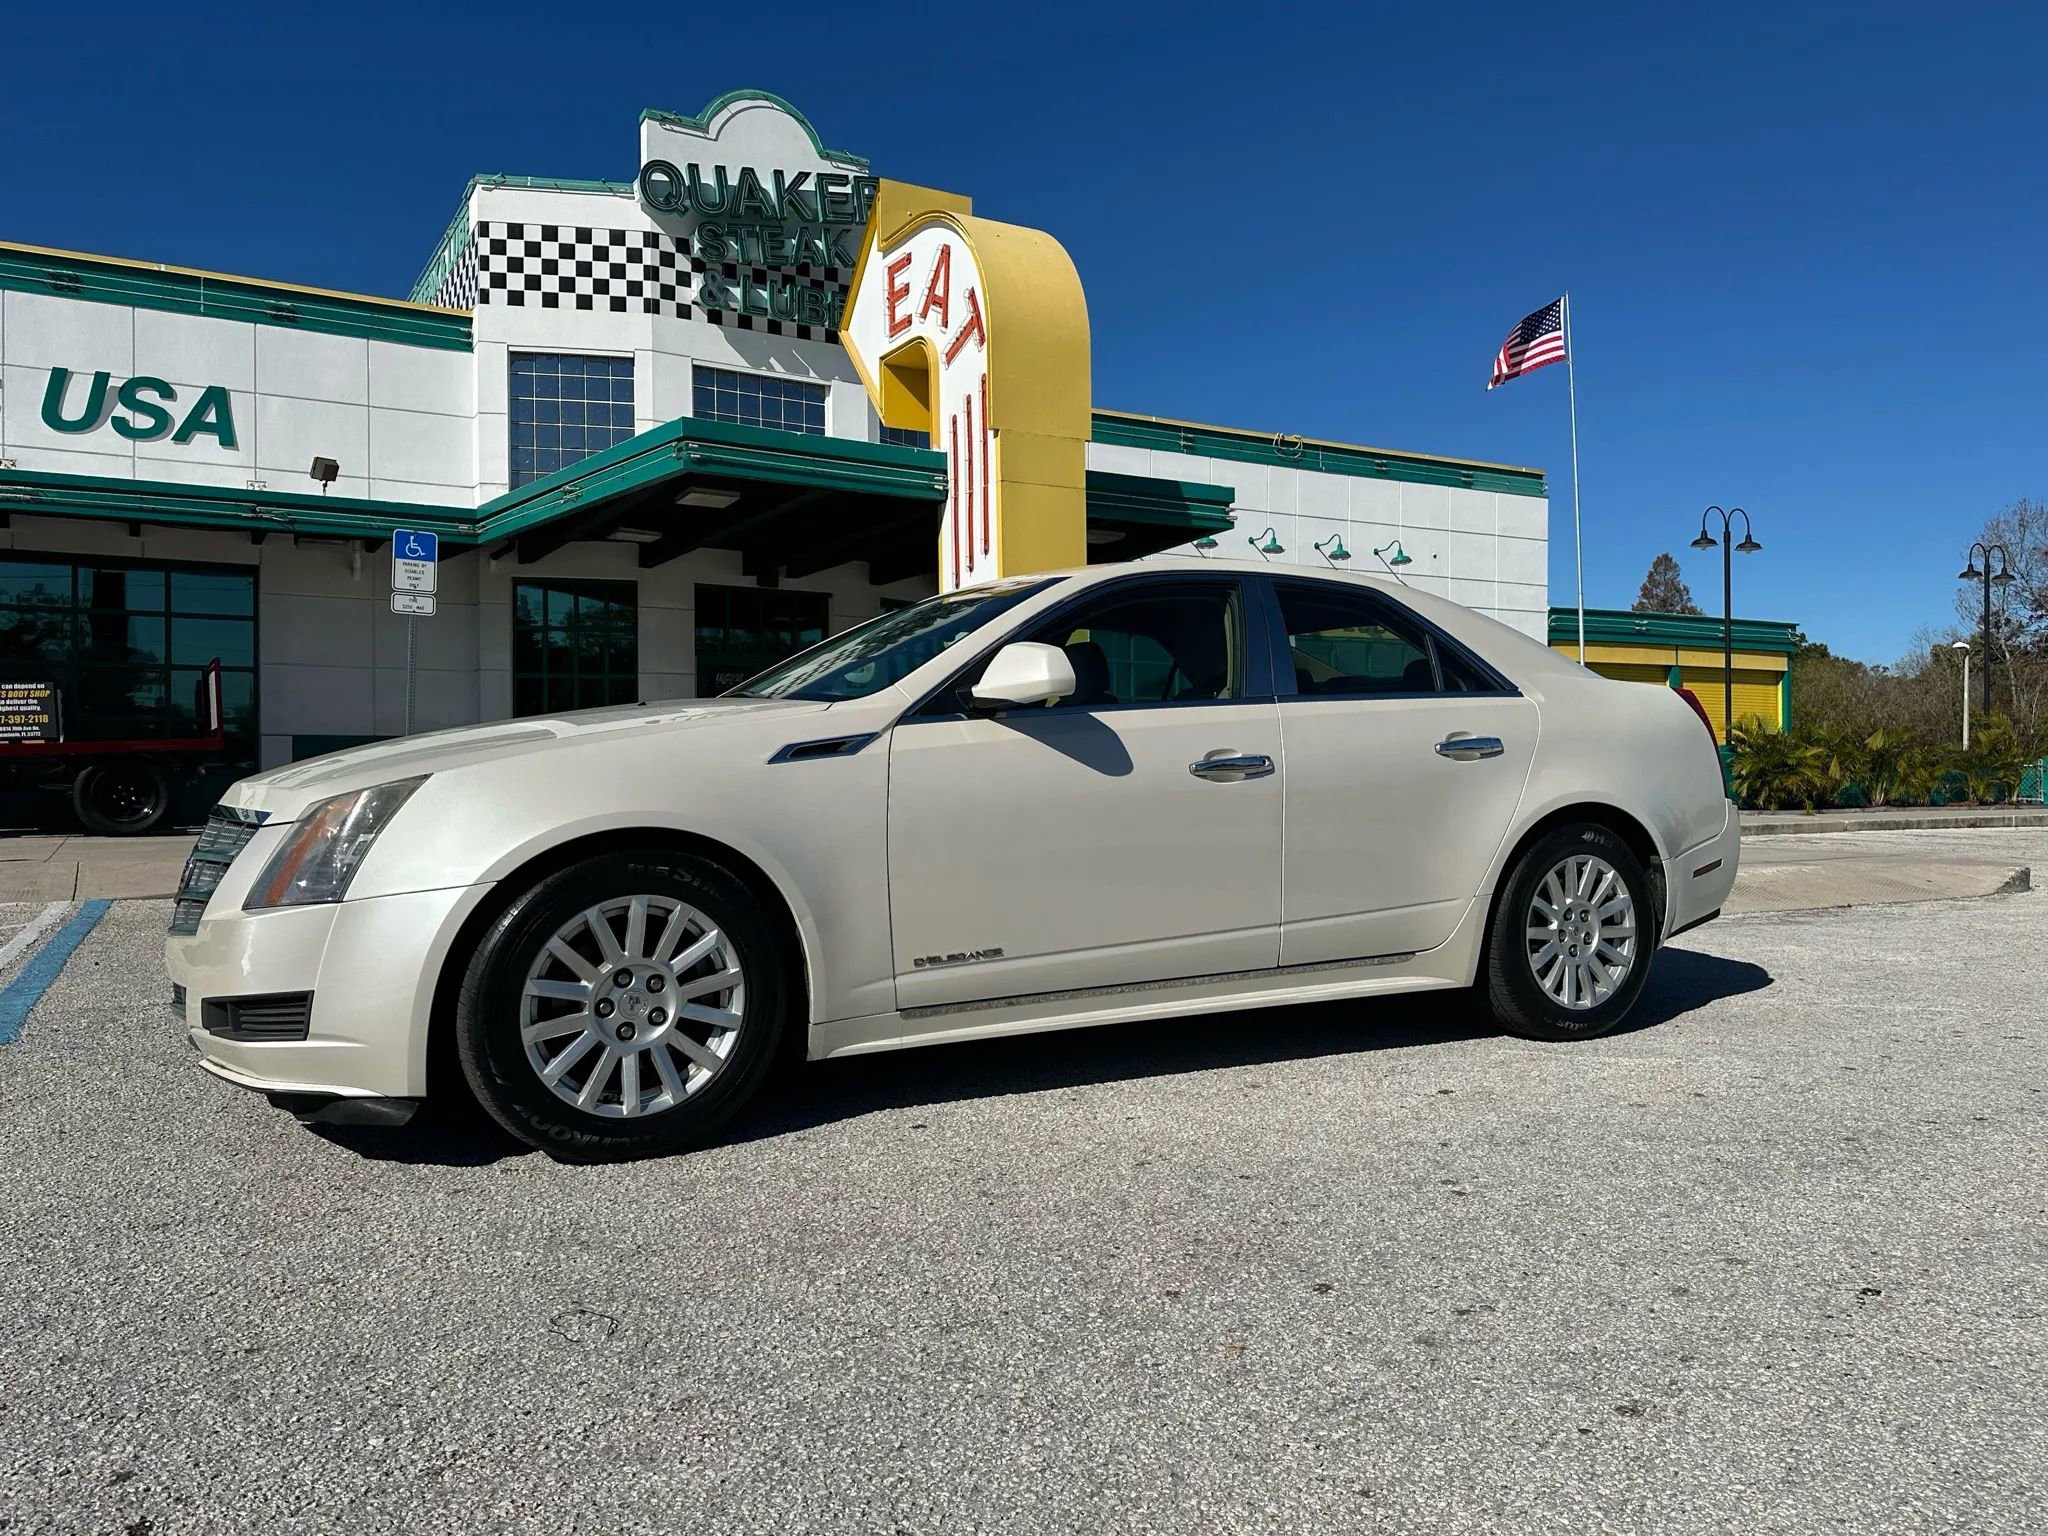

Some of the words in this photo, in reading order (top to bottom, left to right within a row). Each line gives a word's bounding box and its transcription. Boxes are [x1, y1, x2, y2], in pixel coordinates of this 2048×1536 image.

[696, 222, 856, 268] STEAK
[698, 268, 731, 310] &
[883, 244, 986, 369] EAT
[41, 367, 239, 450] USA
